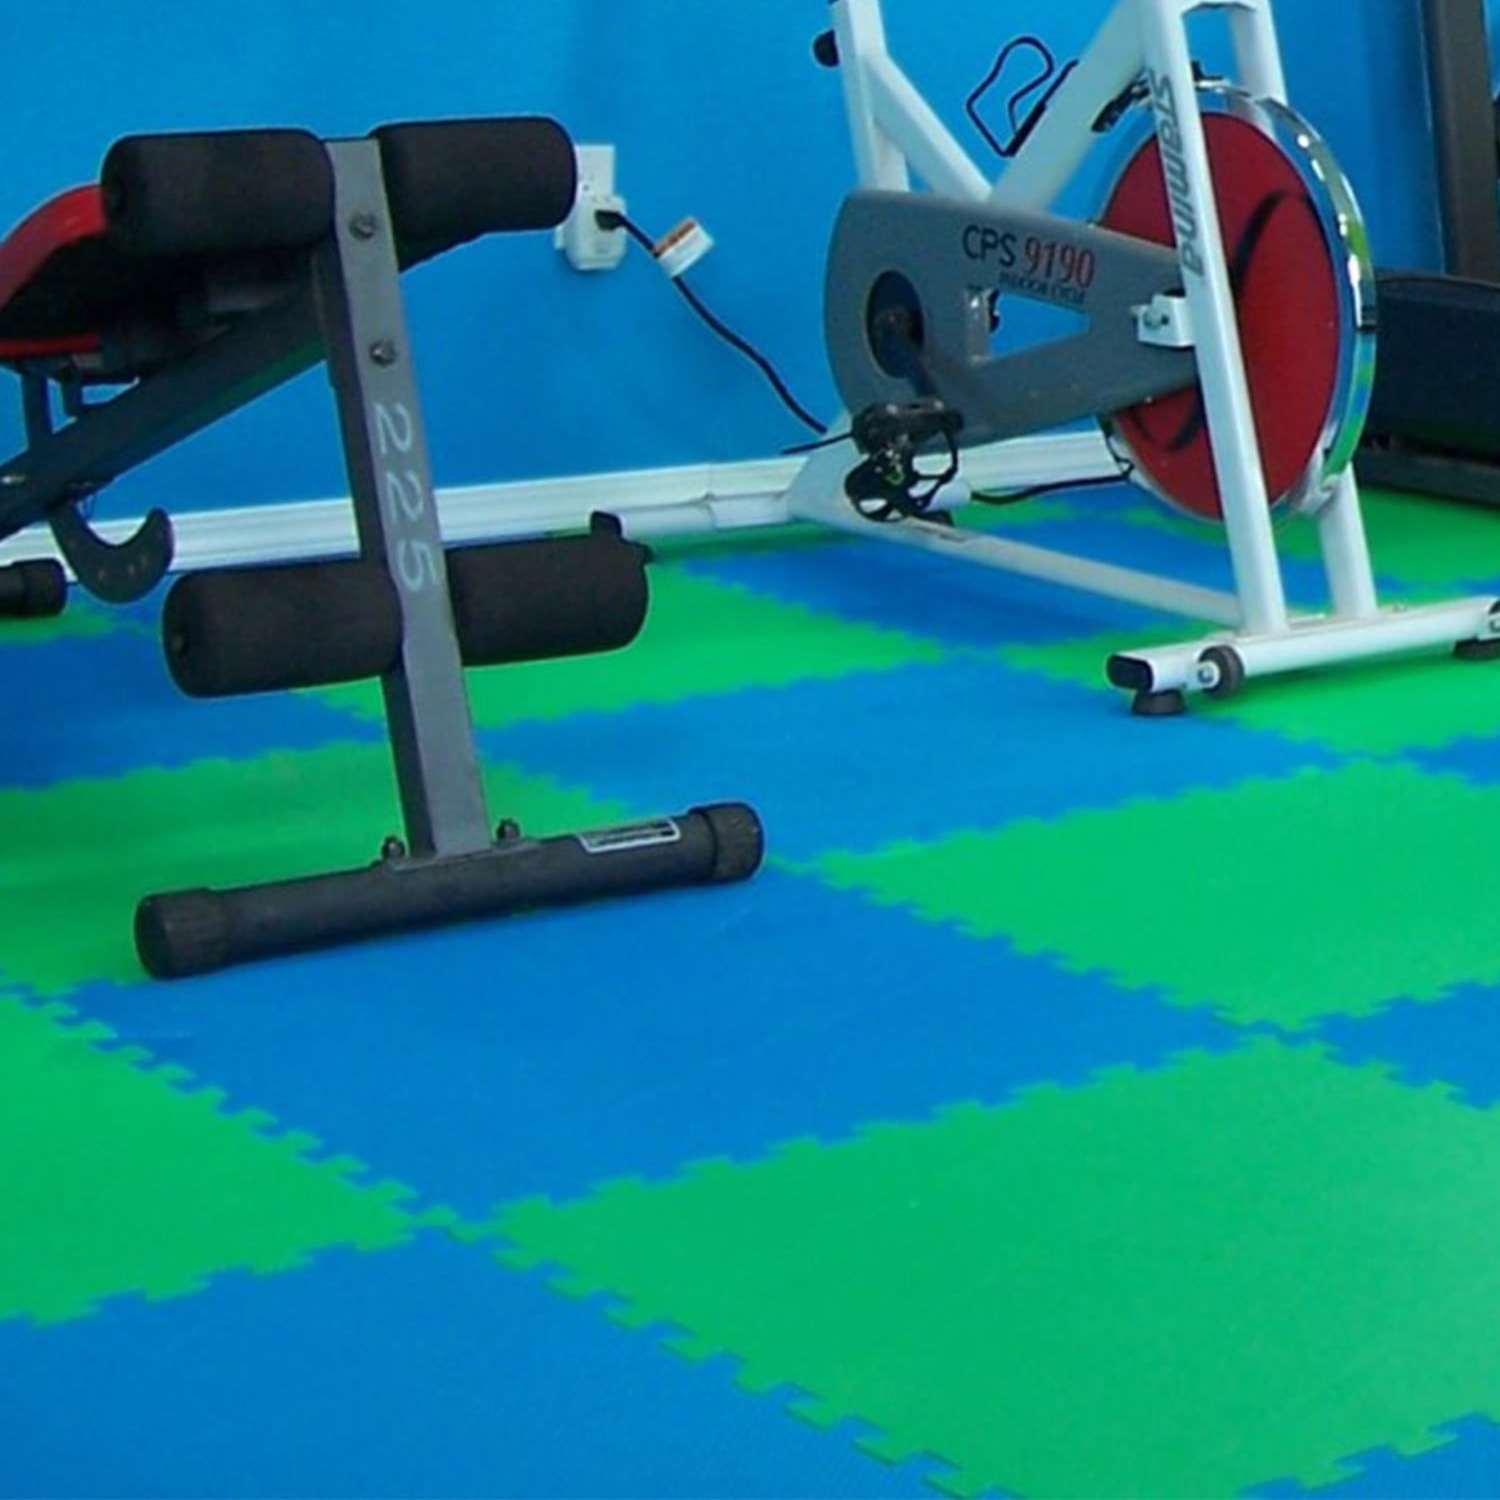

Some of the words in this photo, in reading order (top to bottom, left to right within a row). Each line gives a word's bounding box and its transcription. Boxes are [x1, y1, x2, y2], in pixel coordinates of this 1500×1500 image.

[962, 224, 1017, 268] CPS
[1024, 237, 1096, 289] 9190
[374, 402, 445, 592] 225
